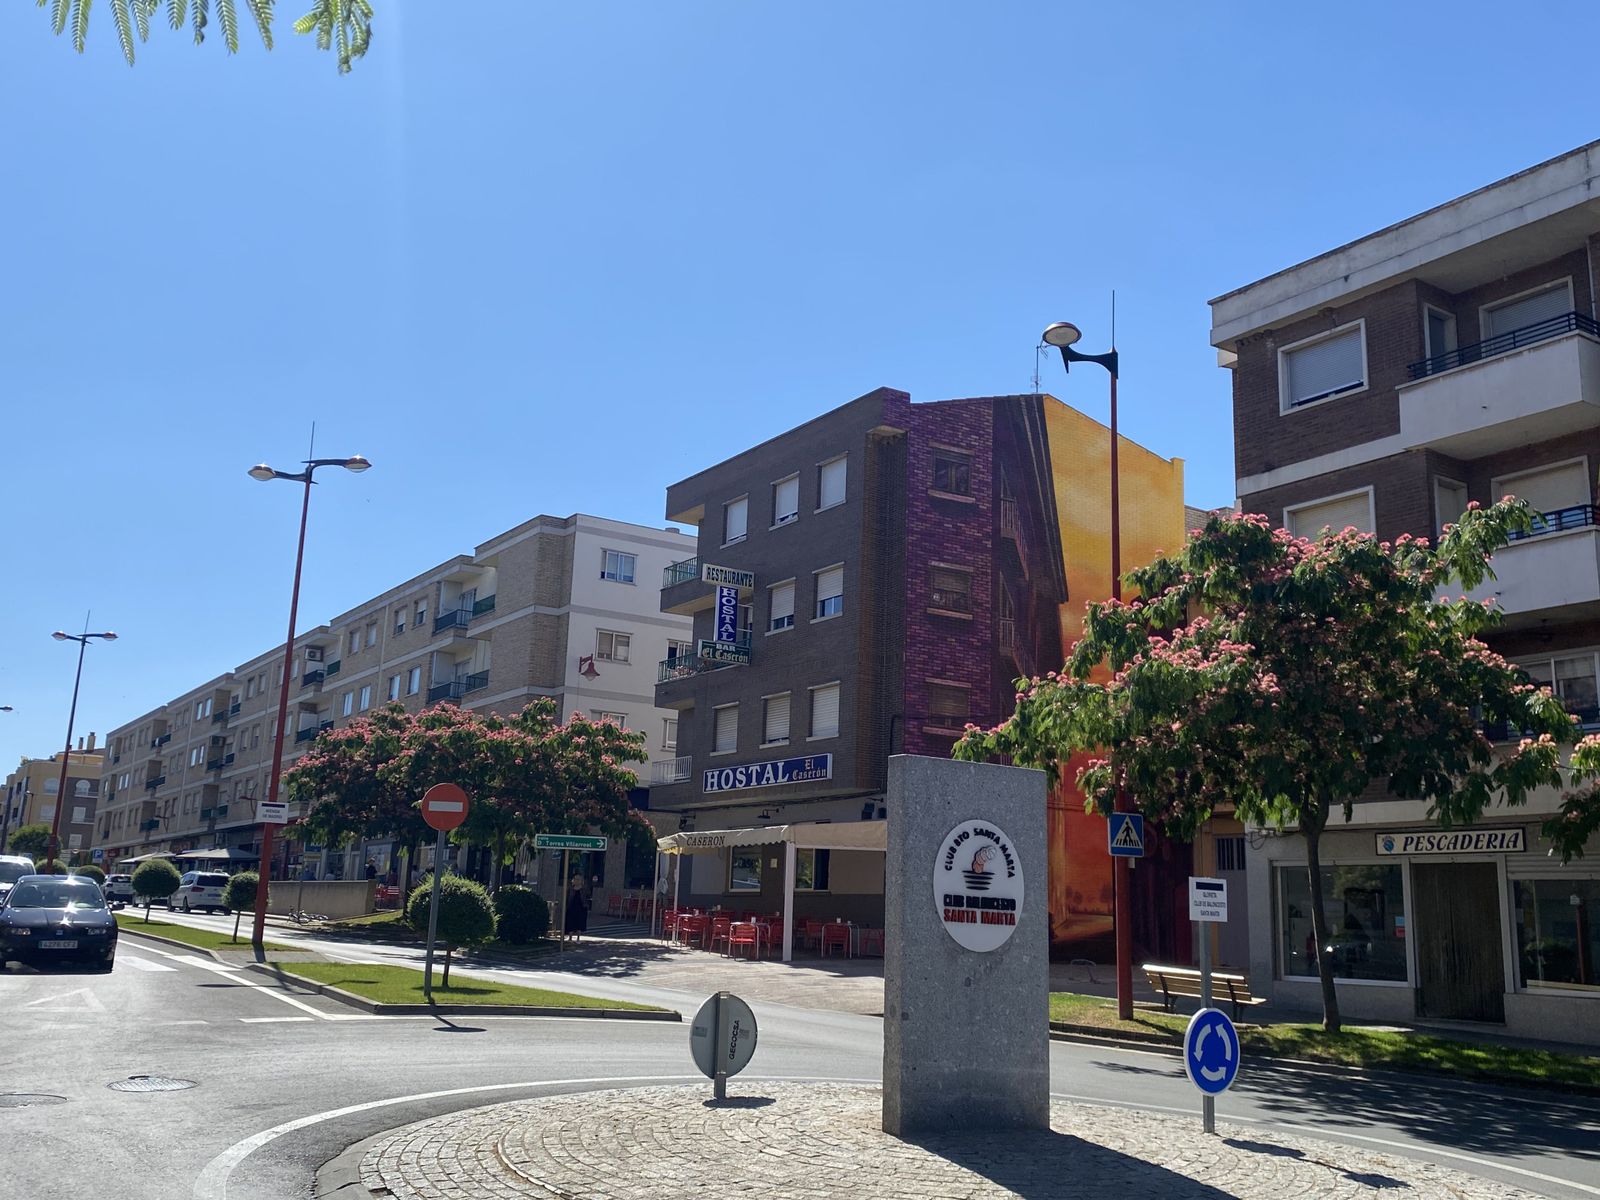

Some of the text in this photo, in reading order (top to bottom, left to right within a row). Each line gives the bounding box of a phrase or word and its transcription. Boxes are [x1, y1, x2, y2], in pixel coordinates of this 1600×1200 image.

[706, 566, 753, 588] RESTAURANTE
[719, 587, 737, 641] HOSTAL
[702, 647, 748, 664] El Caserón
[716, 643, 736, 652] BAR
[792, 766, 827, 780] Caserón
[804, 759, 814, 770] El
[705, 762, 789, 791] HOSTAL
[686, 835, 726, 847] CASERON
[1402, 832, 1520, 852] PESCADERIA
[945, 846, 957, 871] CLUB
[973, 828, 1001, 845] SANTA
[999, 844, 1016, 878] MARTA
[943, 894, 965, 908] CLUB
[943, 908, 1016, 925] SANTA MARTA
